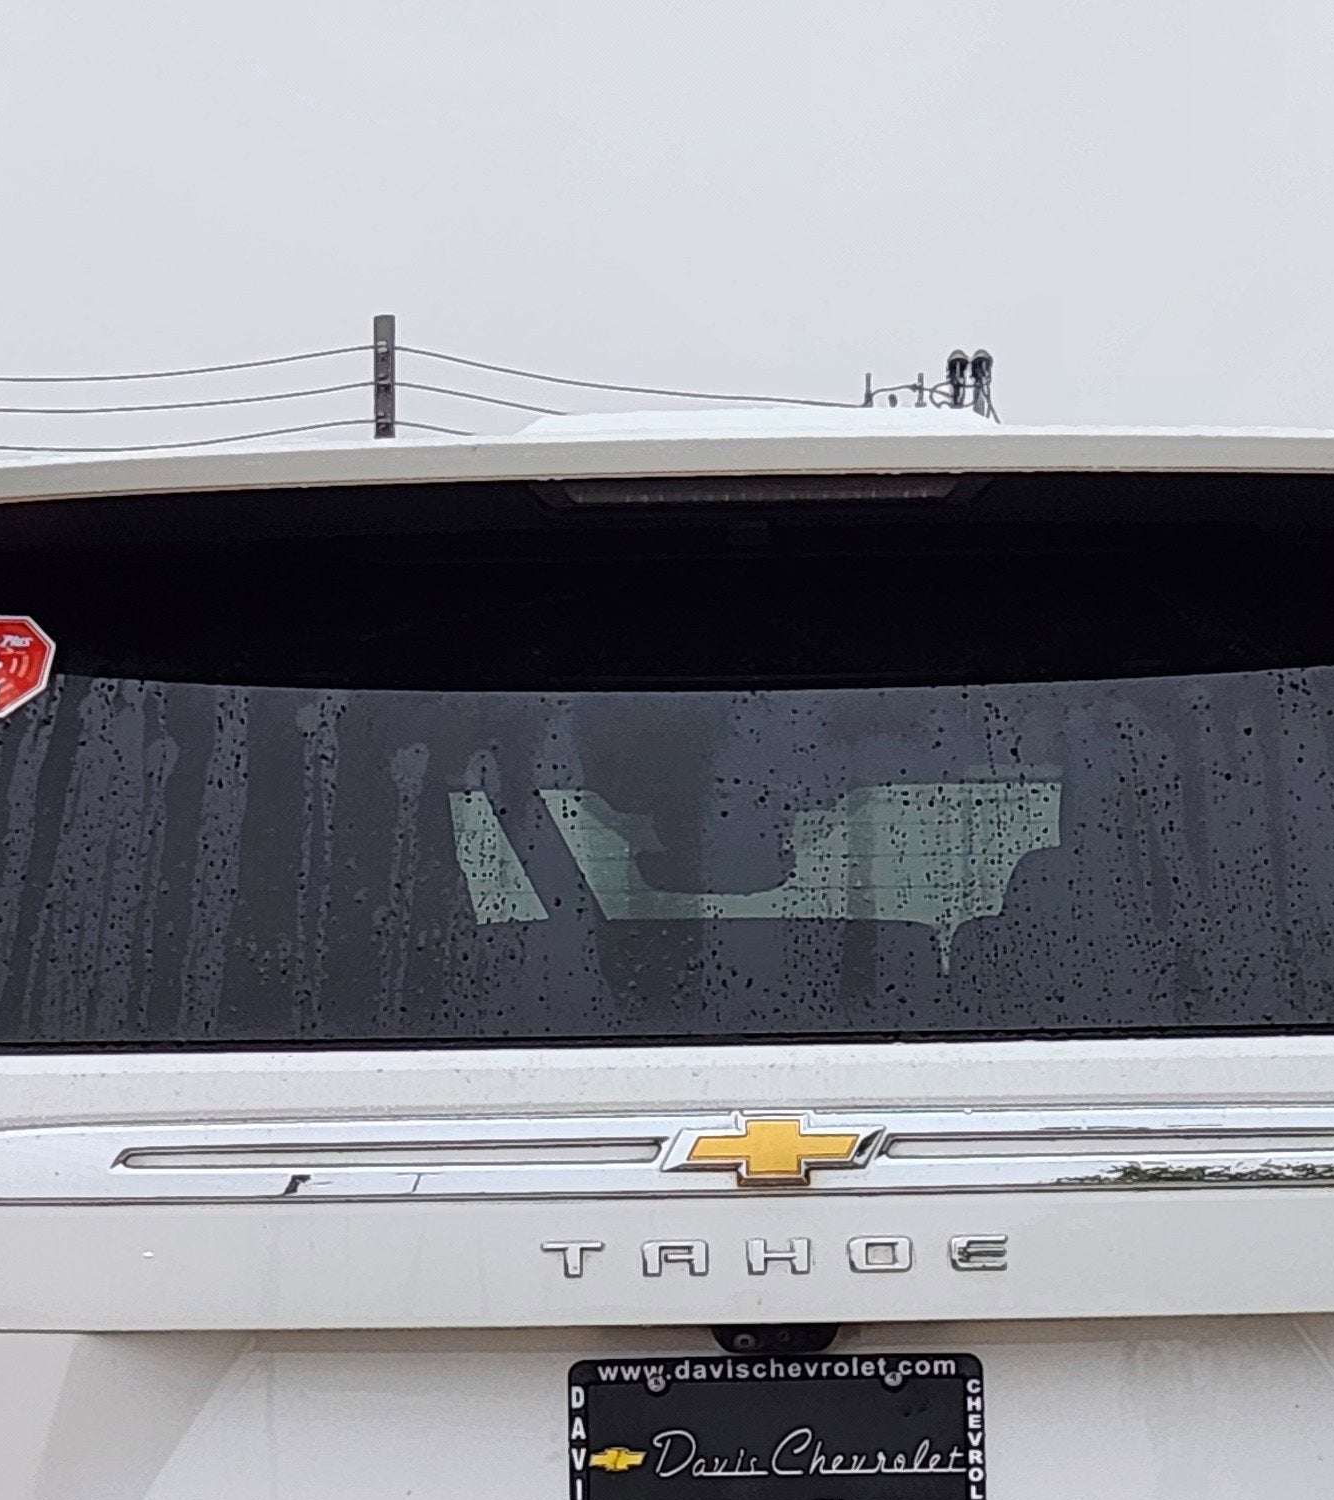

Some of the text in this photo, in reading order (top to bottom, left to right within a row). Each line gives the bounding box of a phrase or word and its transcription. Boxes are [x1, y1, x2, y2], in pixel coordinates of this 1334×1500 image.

[541, 1235, 1009, 1278] TAHOE
[597, 1356, 957, 1382] www.davischevroletcom
[652, 1427, 967, 1478] Davis Chevrolet
